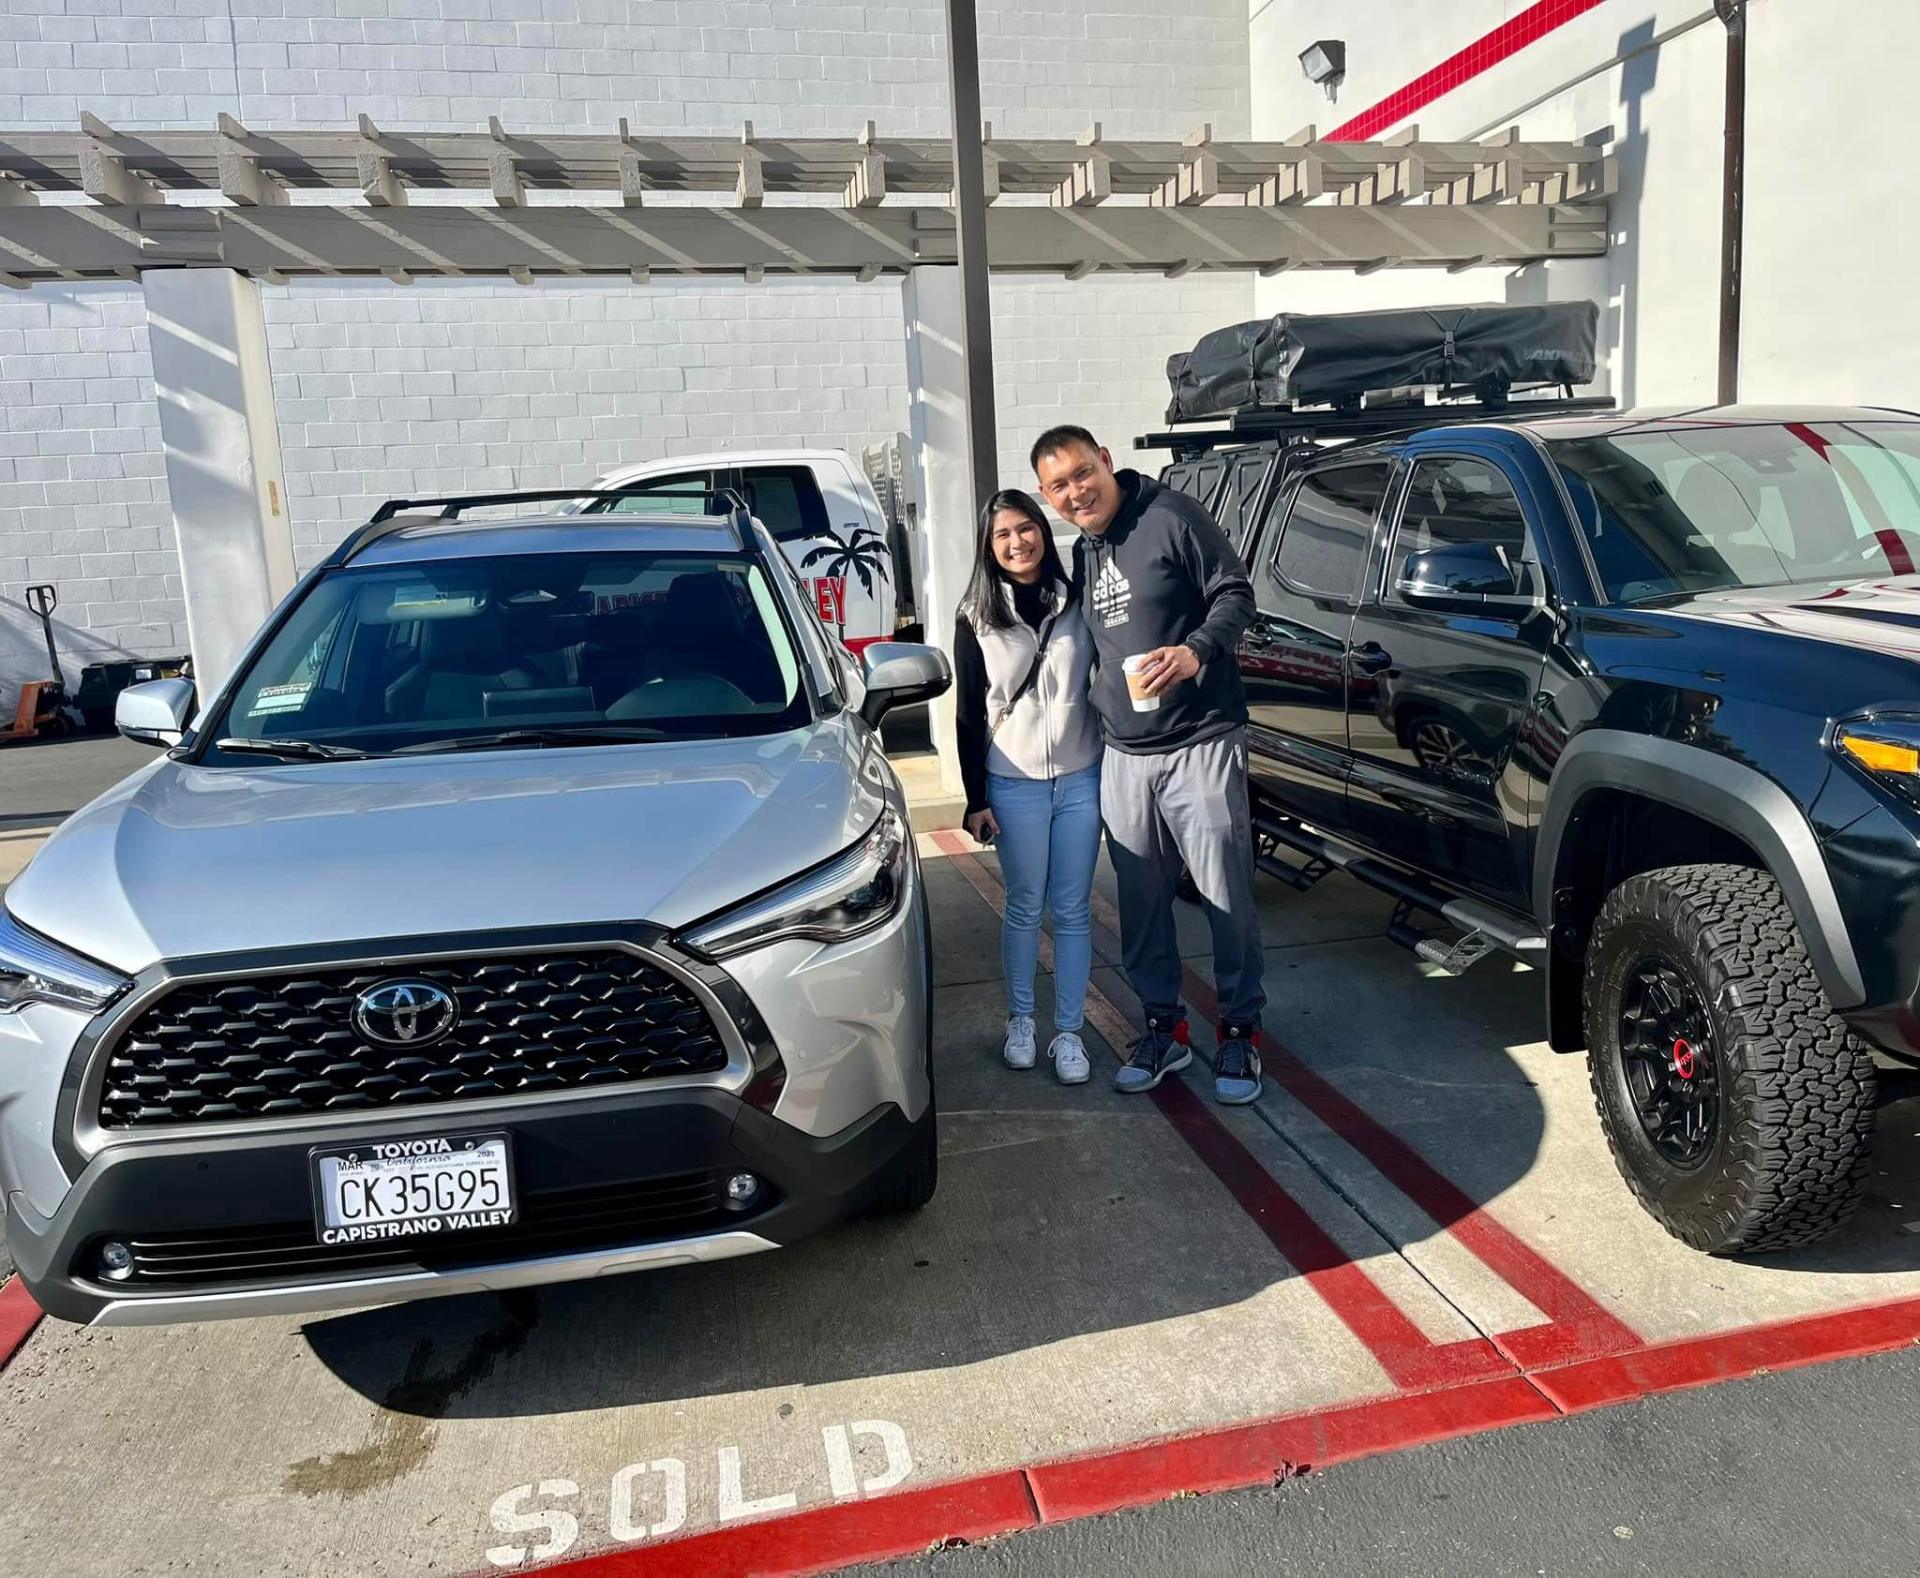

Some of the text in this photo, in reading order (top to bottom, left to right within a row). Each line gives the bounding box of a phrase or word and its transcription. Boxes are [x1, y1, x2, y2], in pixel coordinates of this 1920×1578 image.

[337, 1160, 364, 1172] MAR
[372, 1138, 452, 1159] TOYOTA
[340, 1168, 500, 1219] CK35G95
[322, 1209, 513, 1244] CAPISTRANO VALLEY
[485, 1419, 913, 1566] SOLD
